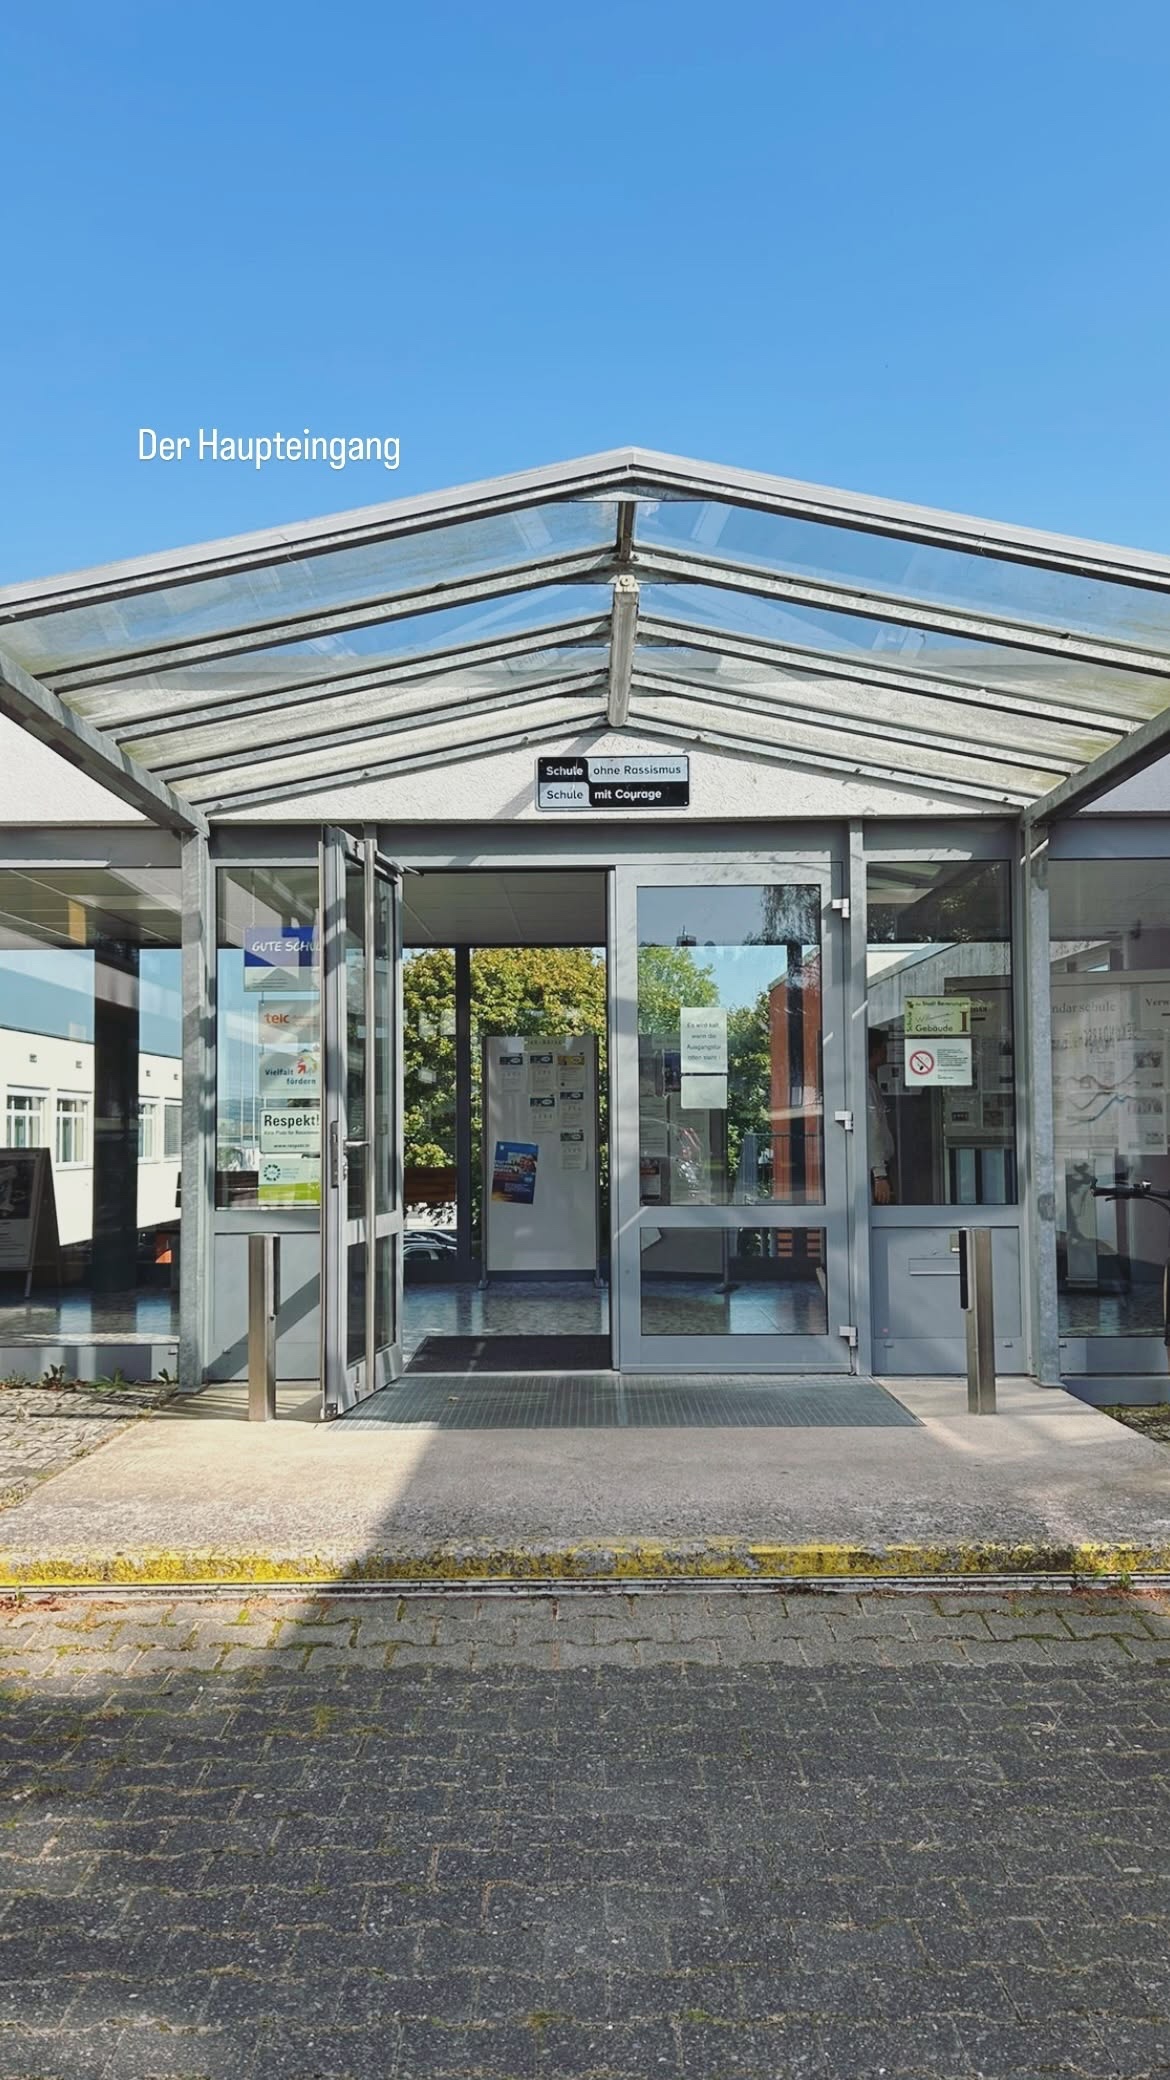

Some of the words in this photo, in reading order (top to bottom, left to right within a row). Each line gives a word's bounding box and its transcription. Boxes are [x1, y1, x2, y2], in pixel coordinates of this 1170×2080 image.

[546, 765, 584, 776] Schule
[593, 765, 620, 775] ohne
[624, 764, 681, 775] Rassismus
[546, 789, 584, 800] Schule
[594, 789, 612, 799] mit
[615, 789, 662, 801] Courage
[252, 941, 283, 952] GUTE
[915, 1024, 953, 1032] Gebäude
[264, 1068, 294, 1076] Vielfalt
[264, 1114, 320, 1129] Respekt!
